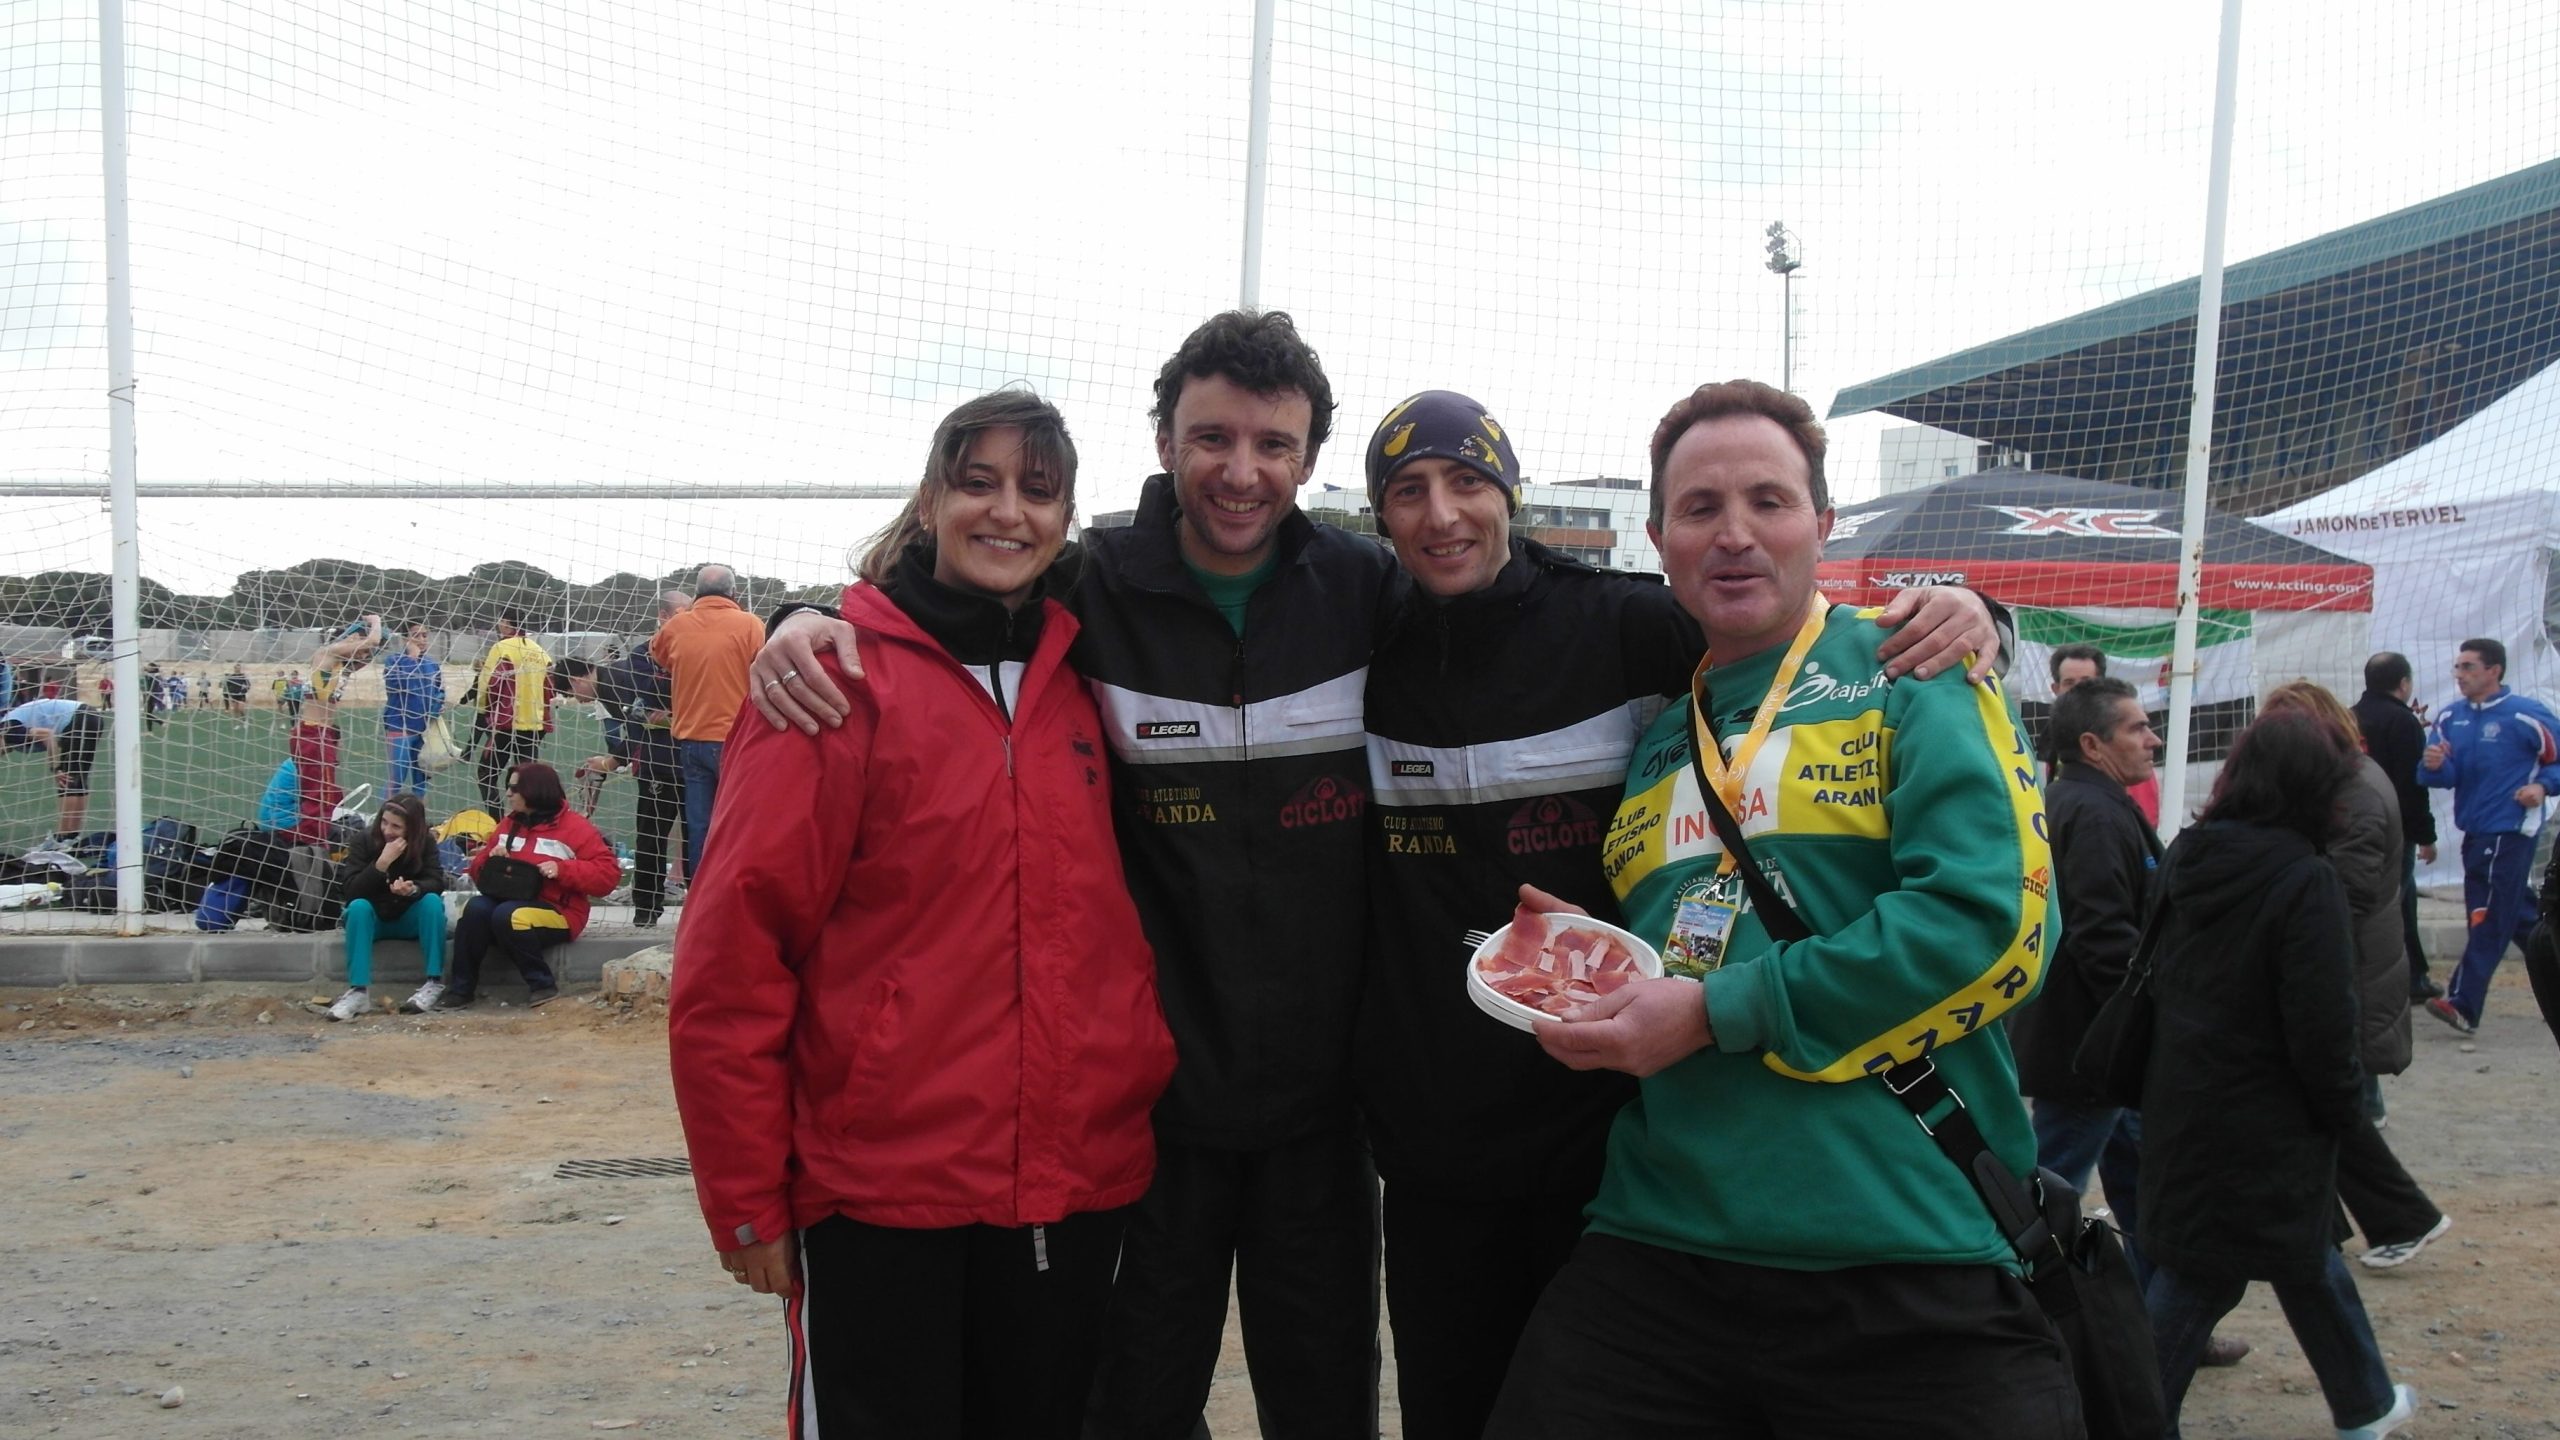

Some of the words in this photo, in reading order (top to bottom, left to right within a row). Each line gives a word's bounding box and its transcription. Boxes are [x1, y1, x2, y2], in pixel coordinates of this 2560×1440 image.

[1975, 505, 2183, 538] XC
[2233, 578, 2361, 594] www.xcting.com
[1150, 724, 1197, 735] LEGEA
[1400, 764, 1432, 774] LEGEA
[1798, 759, 1881, 782] ATLETI
[1153, 787, 1201, 802] ATLETISMO
[1384, 815, 1407, 830] CLUB
[1608, 806, 1647, 834] CLUB
[1603, 813, 1661, 857] ETISMO
